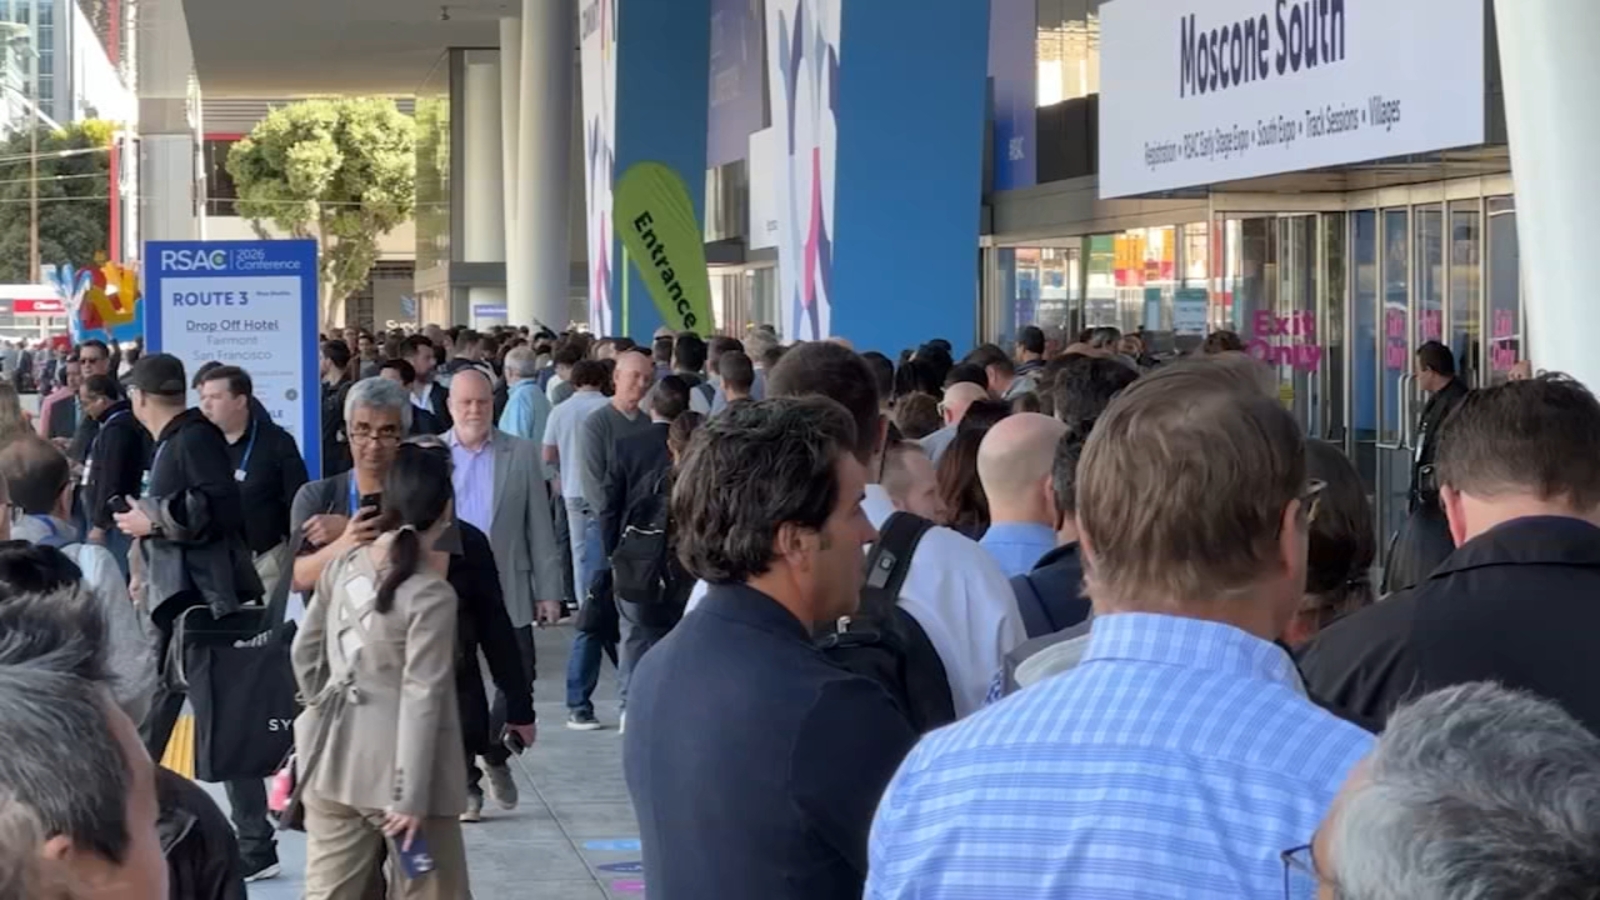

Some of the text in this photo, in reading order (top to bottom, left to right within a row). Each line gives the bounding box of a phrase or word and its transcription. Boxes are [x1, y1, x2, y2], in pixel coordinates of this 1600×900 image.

[1180, 0, 1345, 98] Moscone South
[1144, 140, 1177, 171] Registration
[1200, 128, 1215, 161] Early
[1215, 126, 1232, 159] Stage
[1233, 122, 1249, 157] Expo
[1257, 116, 1277, 146] South
[1278, 114, 1295, 149] Expo
[1306, 105, 1325, 138] Track
[1326, 102, 1359, 134] Sessions
[1368, 95, 1401, 132] Villages
[161, 249, 227, 271] RSAC
[236, 249, 265, 260] 2026
[235, 259, 301, 270] Conference
[634, 210, 698, 330] Entrance
[172, 291, 235, 306] ROUTE
[239, 291, 249, 306] 3
[186, 319, 279, 333] Drop Off Hotel
[1253, 310, 1317, 336] Exit
[206, 335, 259, 346] Fairmont
[192, 350, 273, 361] San Francisco
[1245, 338, 1321, 371] Only
